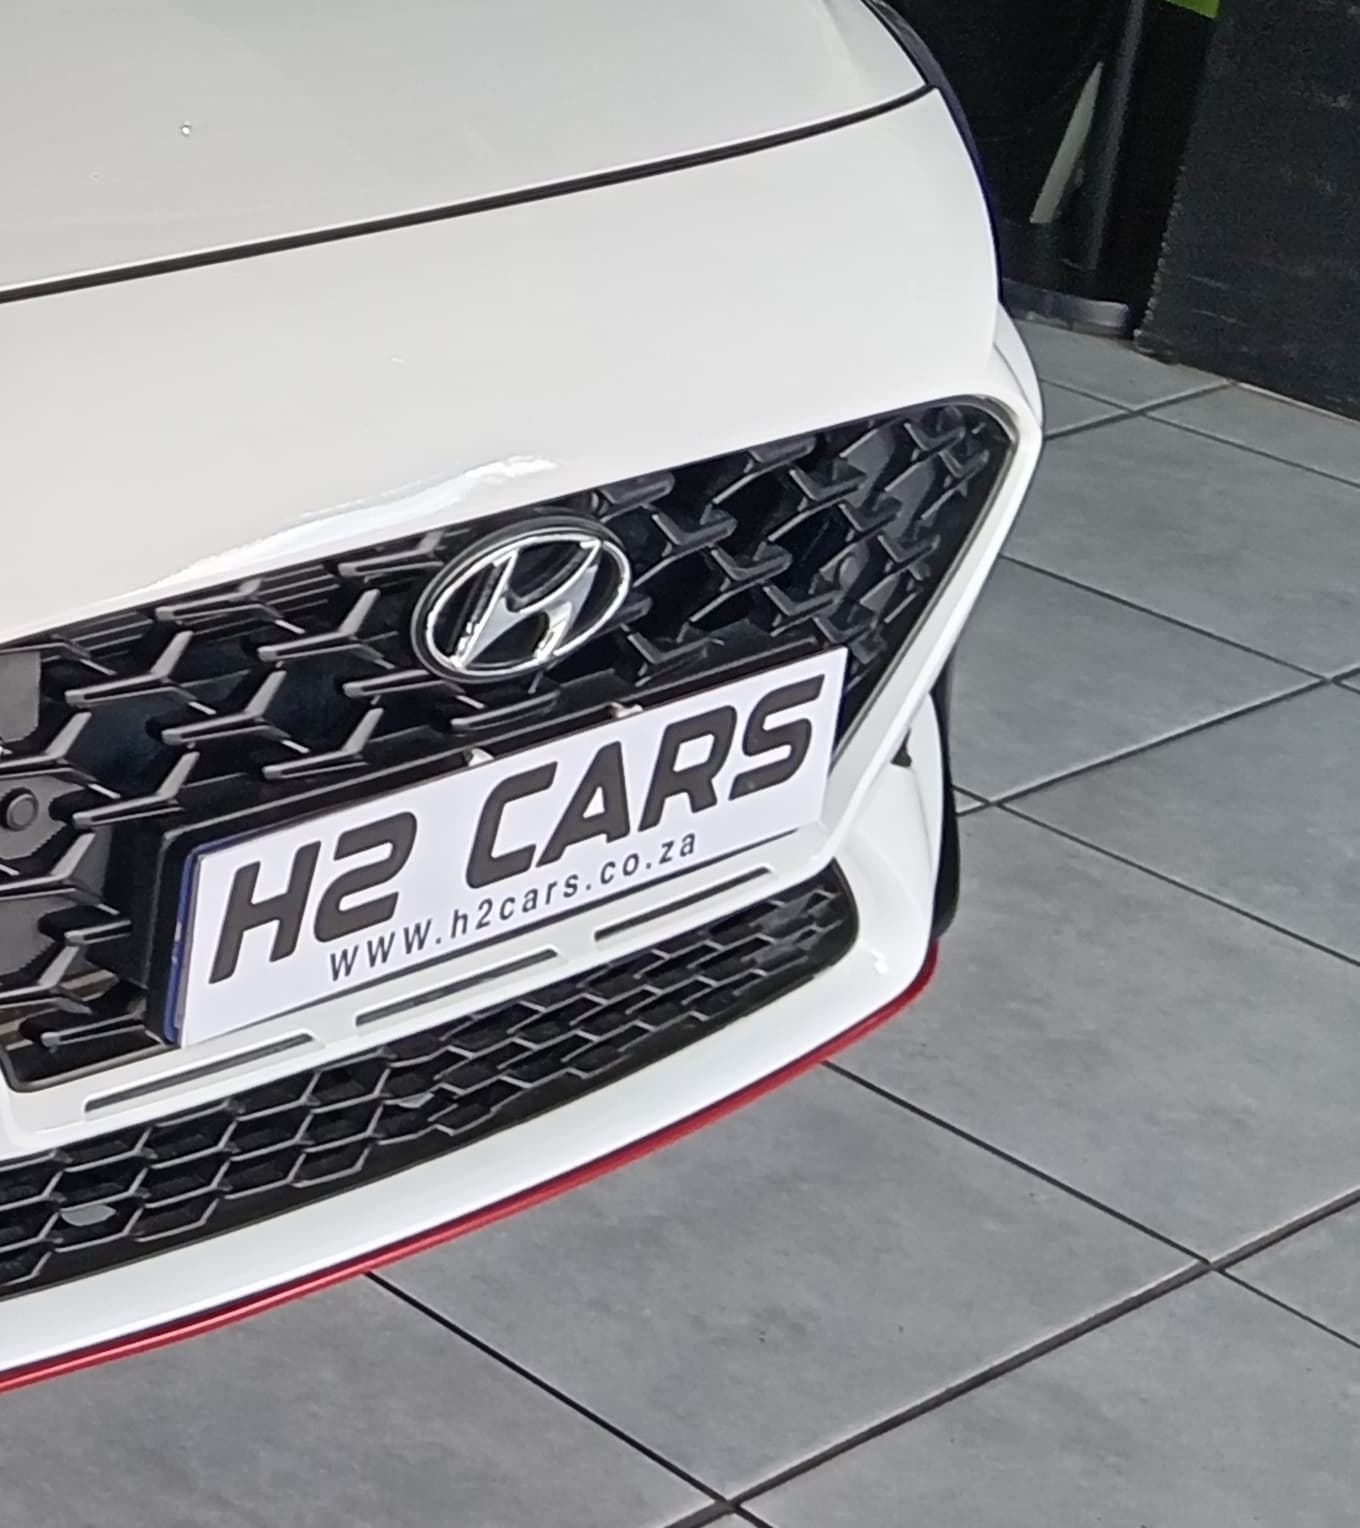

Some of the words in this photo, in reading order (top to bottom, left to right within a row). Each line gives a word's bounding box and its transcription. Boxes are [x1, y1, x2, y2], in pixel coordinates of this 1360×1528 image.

[206, 810, 419, 986] H2
[463, 673, 828, 891] CARS
[328, 829, 698, 984] www.h2cars.co.za
